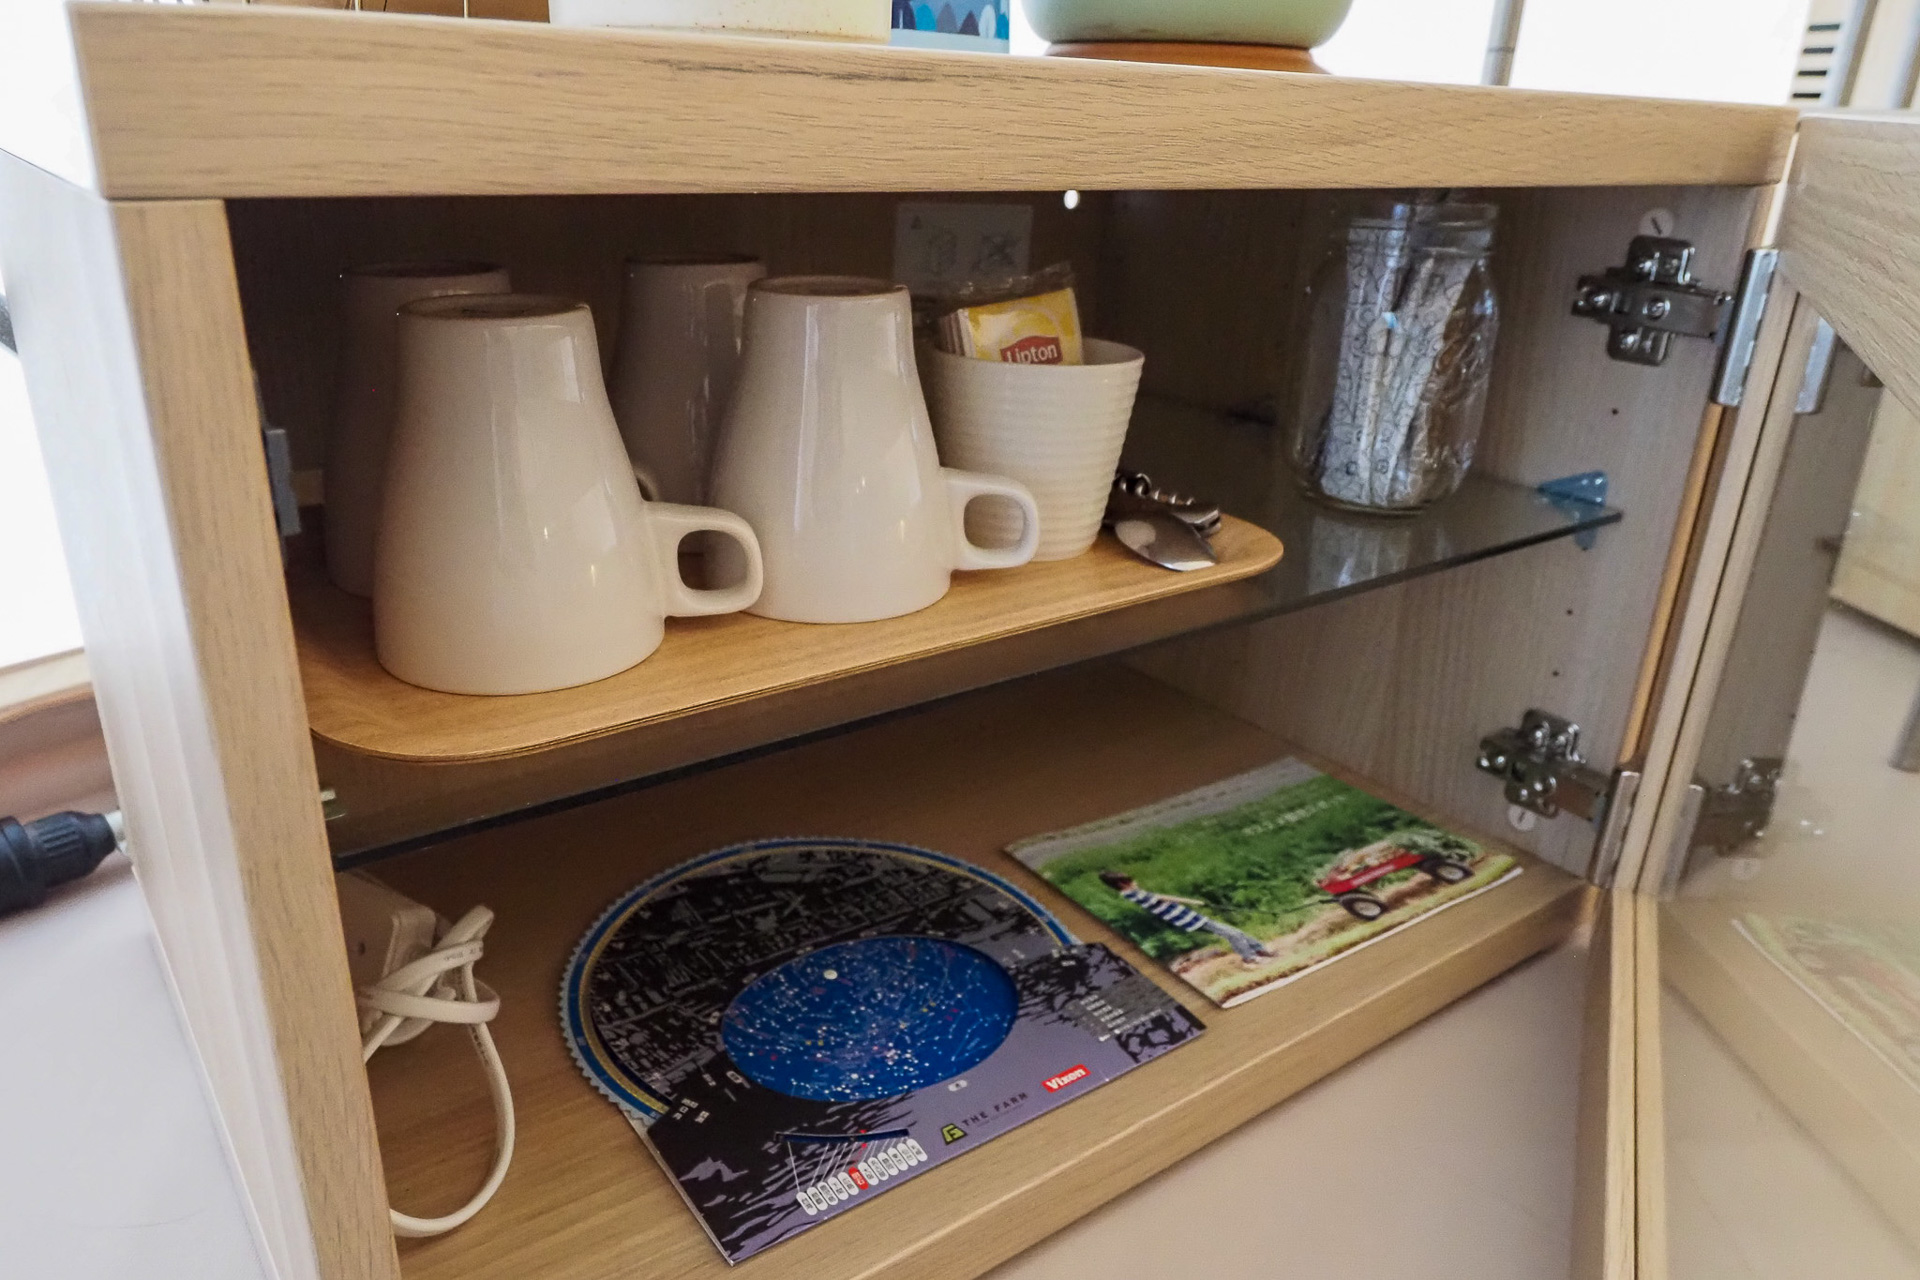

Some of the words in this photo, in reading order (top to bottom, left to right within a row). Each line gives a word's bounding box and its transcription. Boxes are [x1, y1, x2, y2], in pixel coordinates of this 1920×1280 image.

[1006, 344, 1058, 364] Lipton
[961, 1111, 989, 1127] THE
[993, 1092, 1028, 1113] FARM
